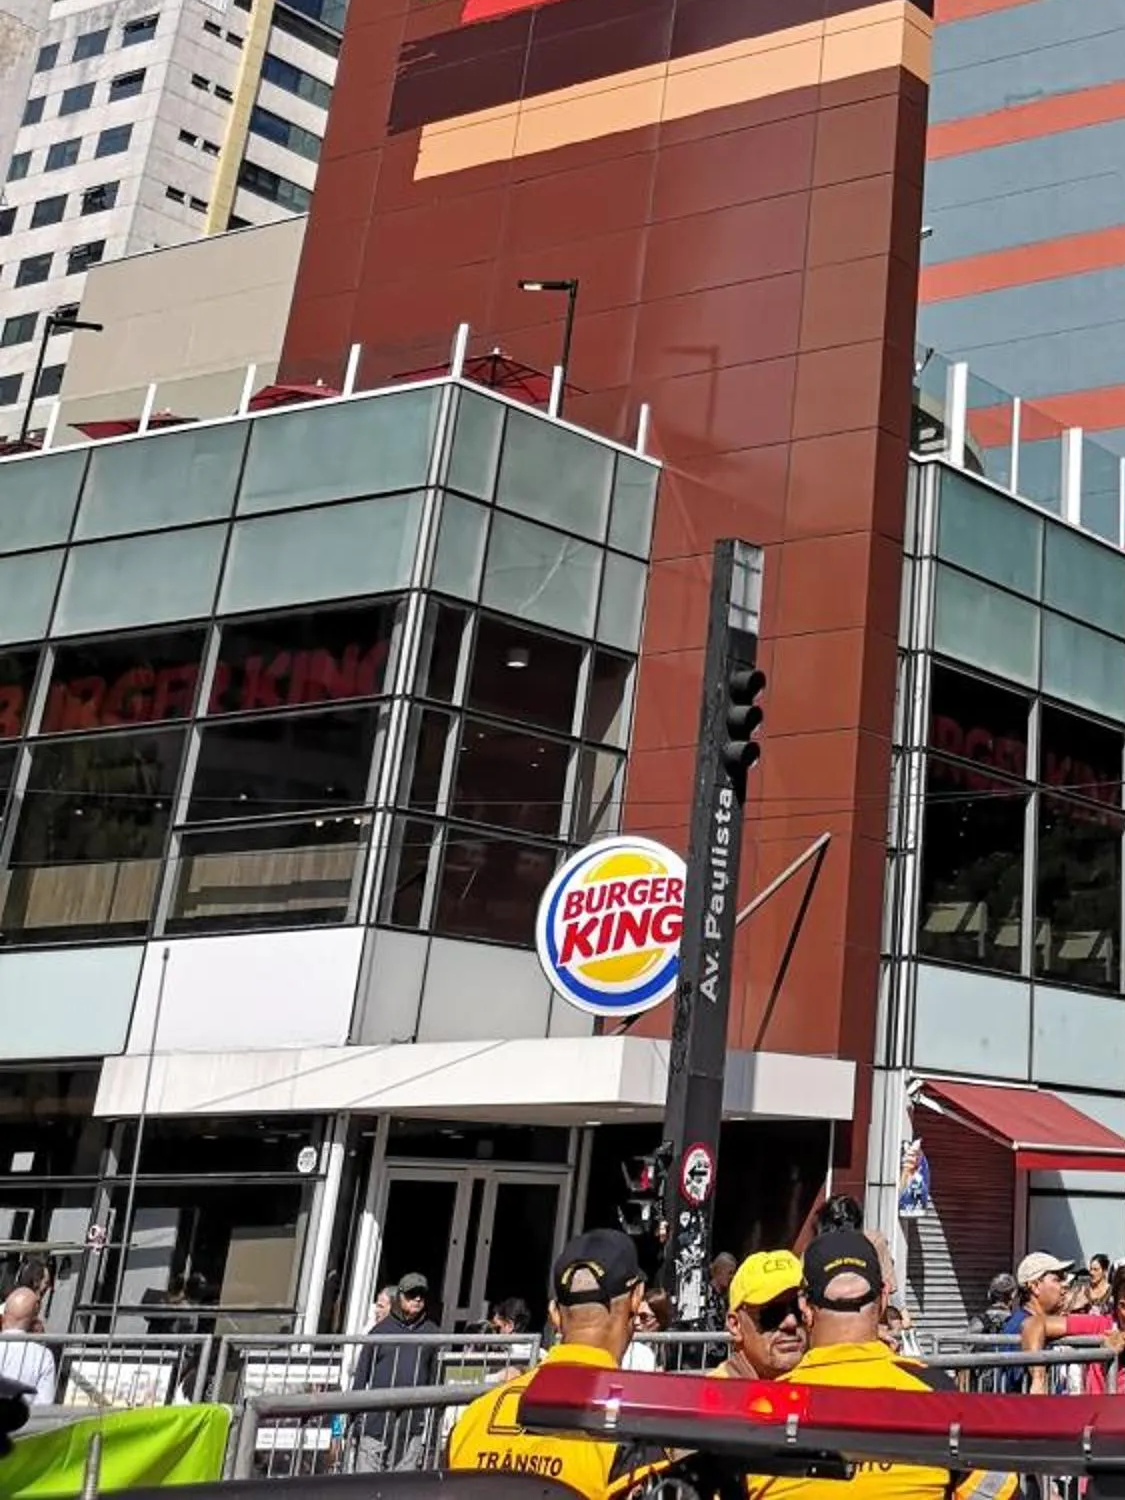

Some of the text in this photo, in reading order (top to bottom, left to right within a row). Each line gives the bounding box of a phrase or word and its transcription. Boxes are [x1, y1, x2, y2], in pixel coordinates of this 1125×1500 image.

[562, 876, 684, 922] BURGER
[699, 787, 734, 1003] Av. Paulista
[559, 904, 686, 965] KING
